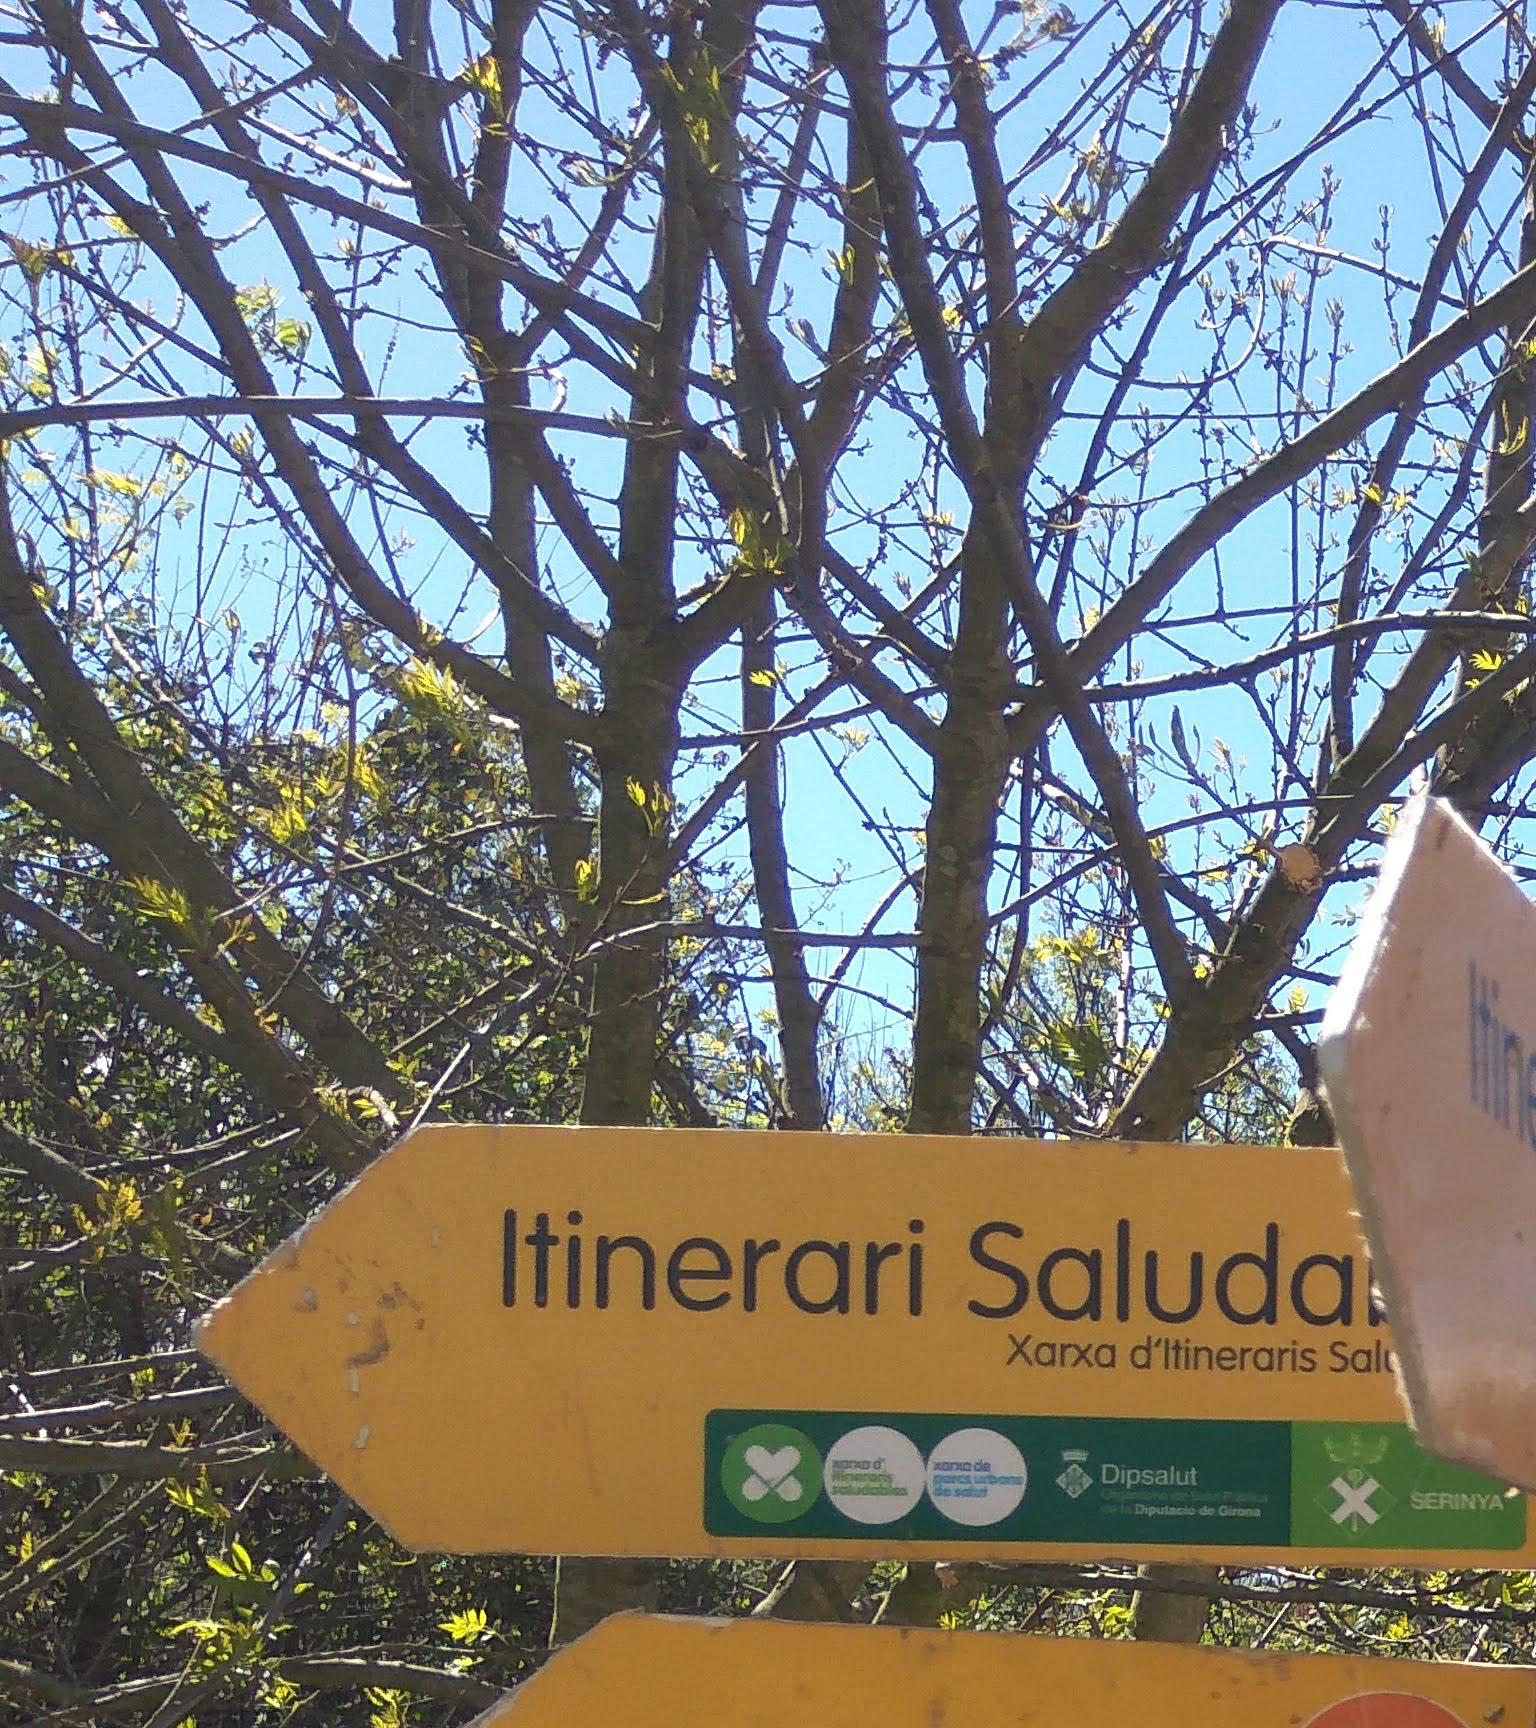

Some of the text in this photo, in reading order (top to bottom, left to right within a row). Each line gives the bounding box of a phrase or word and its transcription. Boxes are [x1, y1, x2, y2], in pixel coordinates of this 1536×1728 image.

[502, 1208, 925, 1317] Itinerari
[1006, 1332, 1117, 1369] Xarxa
[1130, 1335, 1317, 1373] d'Itineraris
[1101, 1463, 1199, 1489] Dipsalut
[1218, 1505, 1261, 1517] Girona
